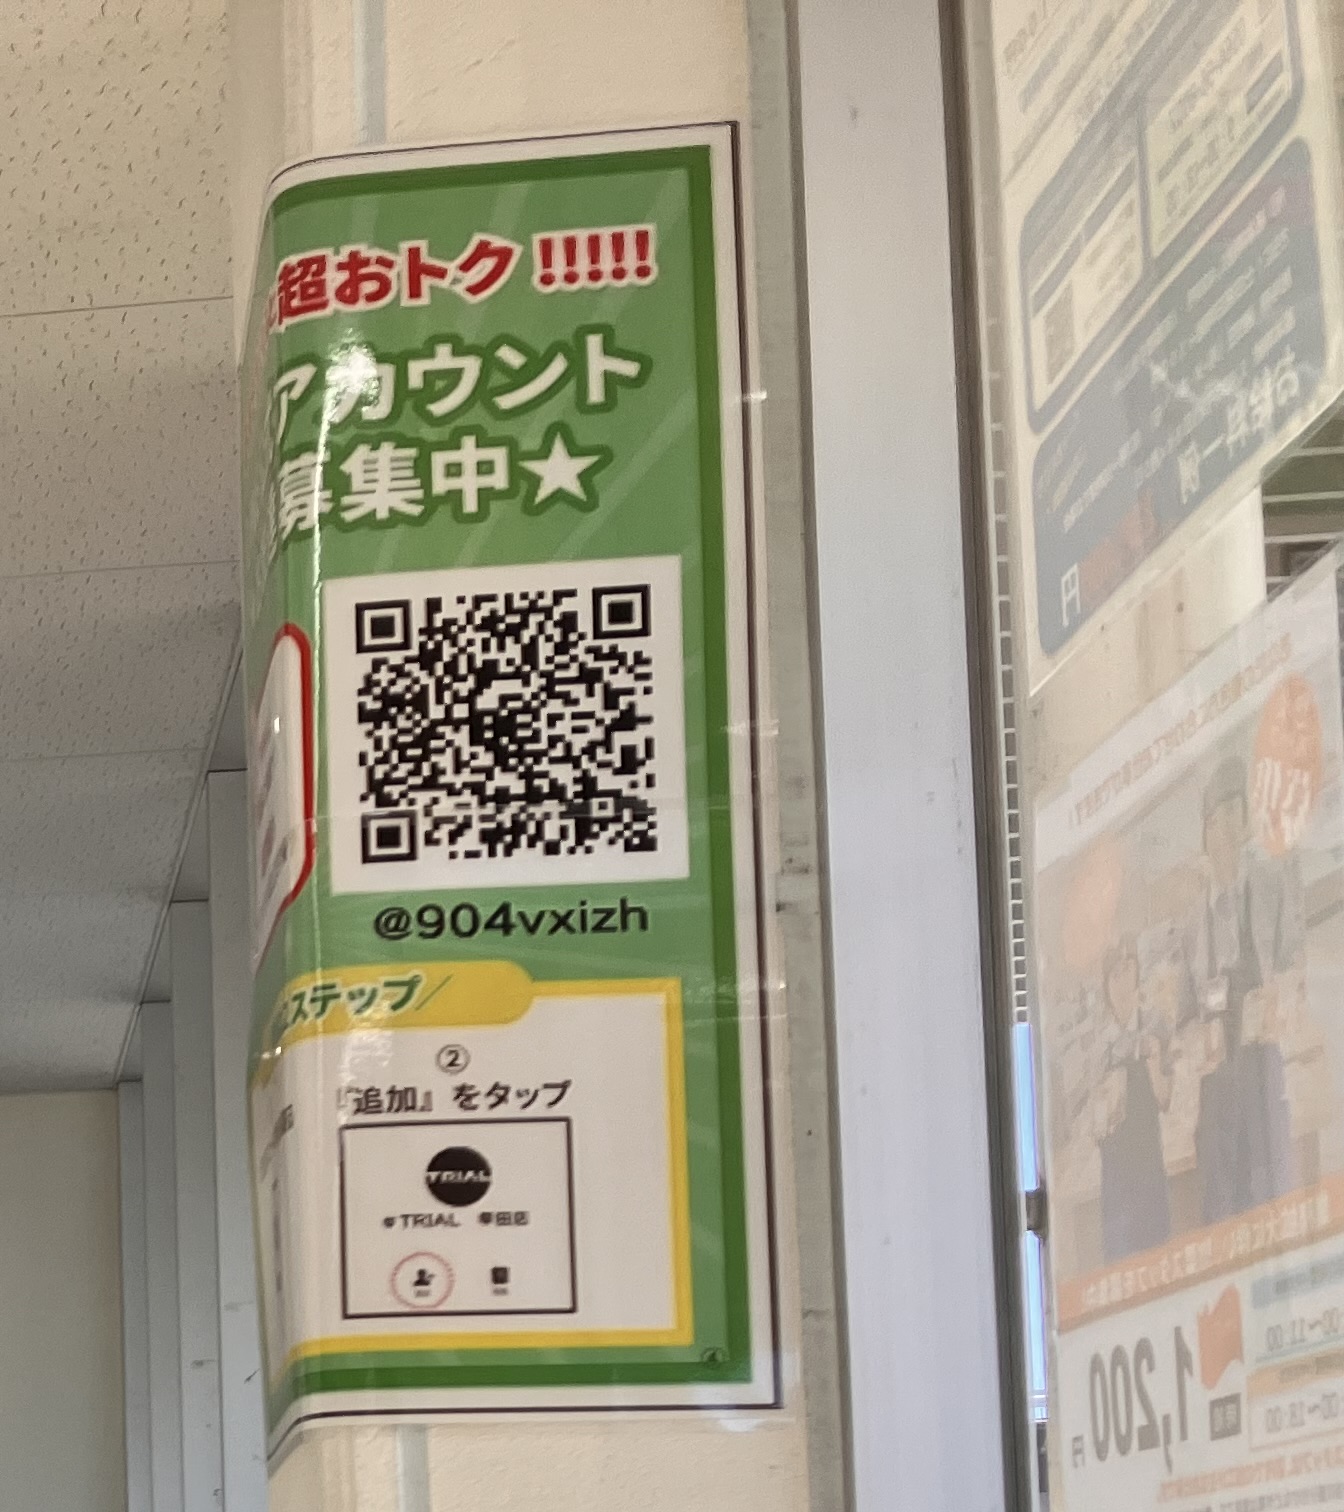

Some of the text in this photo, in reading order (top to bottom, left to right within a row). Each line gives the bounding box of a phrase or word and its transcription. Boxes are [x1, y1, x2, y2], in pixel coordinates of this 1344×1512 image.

[374, 897, 648, 941] @904vxizh
[427, 1170, 491, 1183] TRIAL
[400, 1213, 460, 1228] TRIAL
